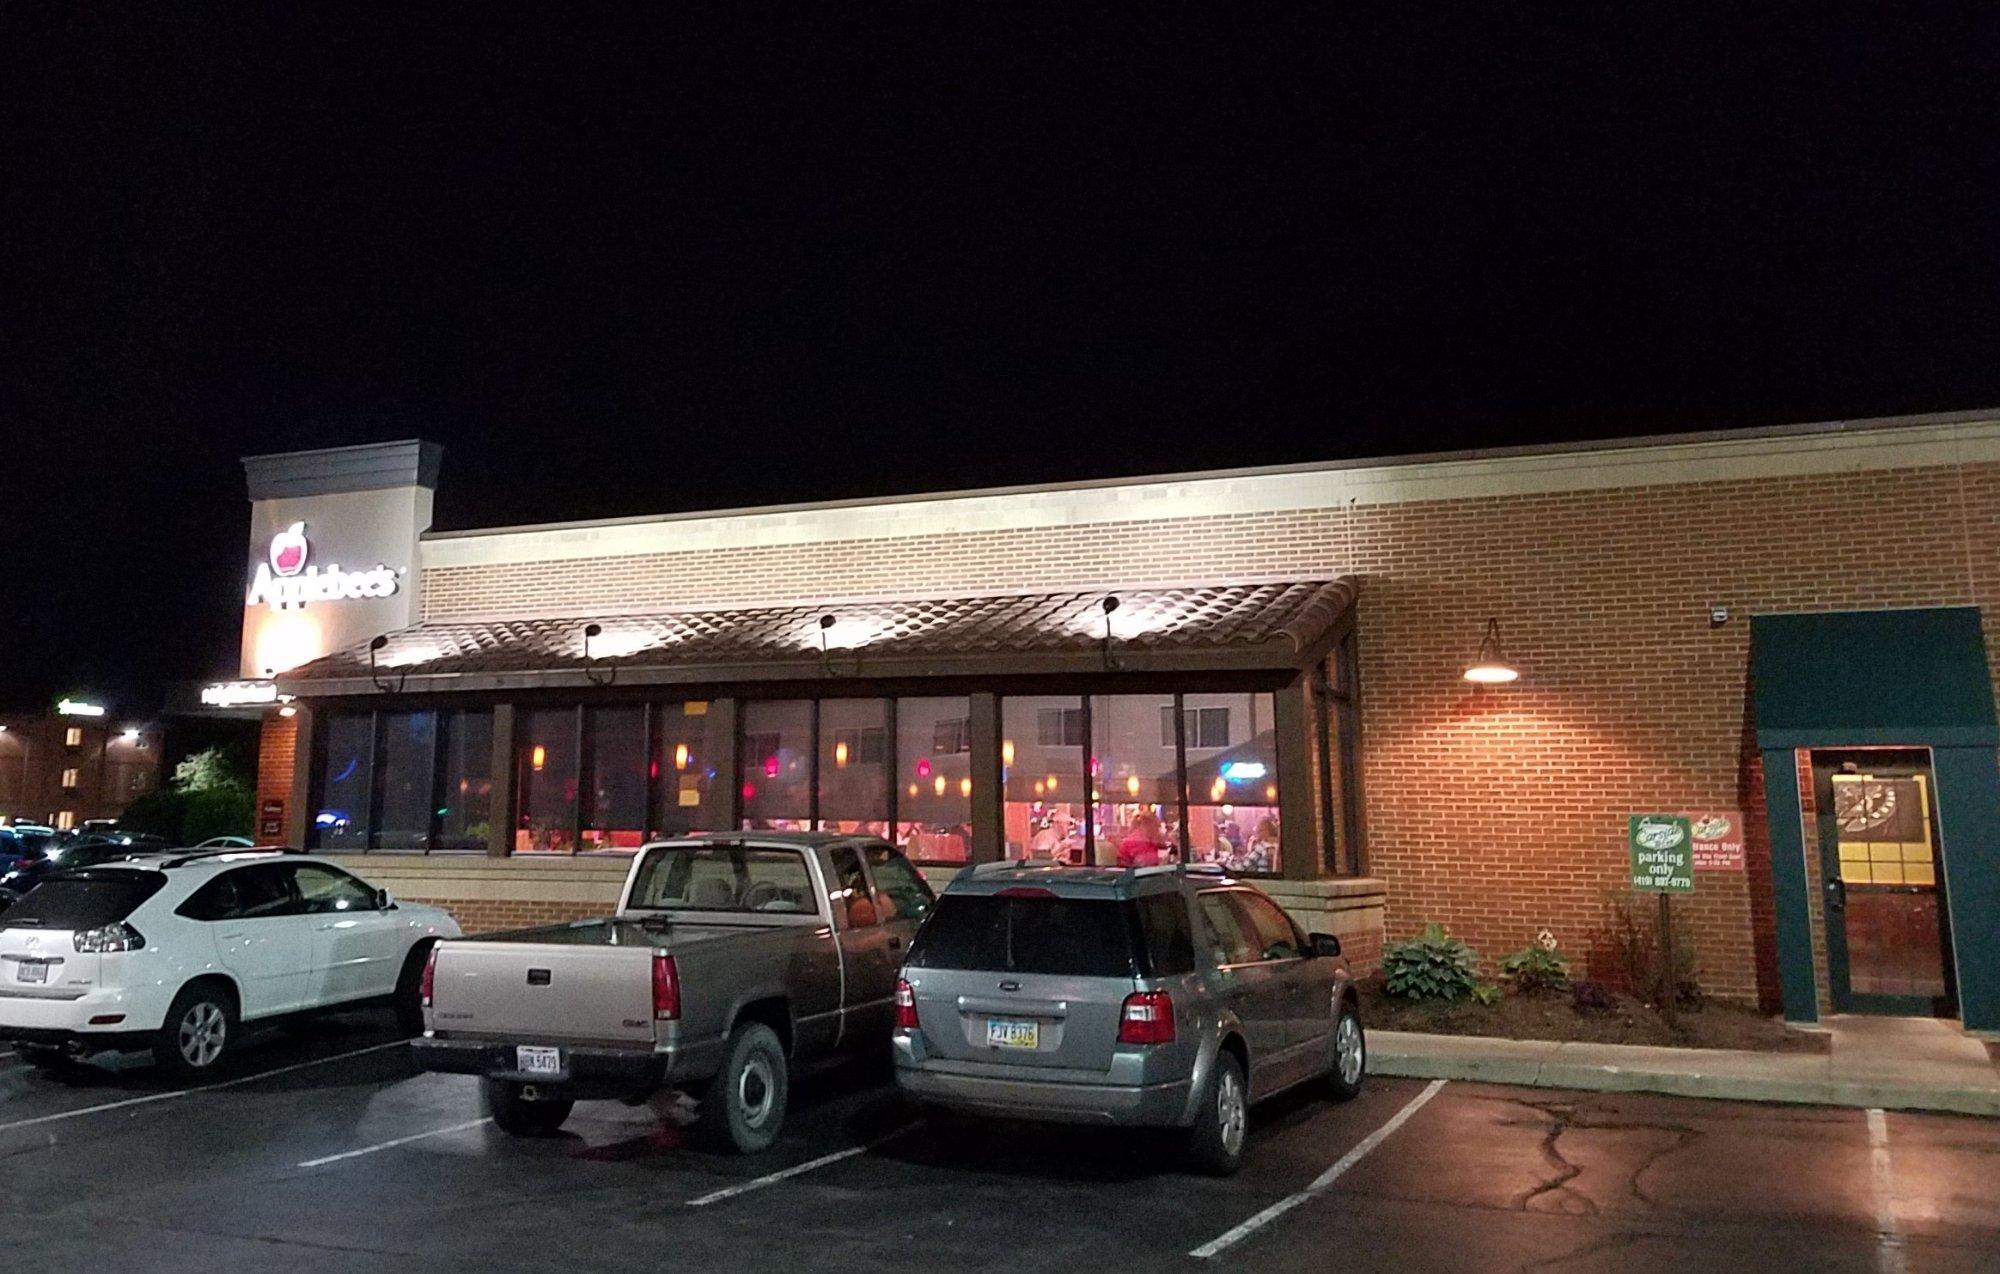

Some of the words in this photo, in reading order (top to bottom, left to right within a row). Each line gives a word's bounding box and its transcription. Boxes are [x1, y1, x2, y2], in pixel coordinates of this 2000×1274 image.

[247, 562, 399, 609] Applebee's
[1721, 842, 1741, 852] Only
[1638, 850, 1684, 867] parking
[1649, 863, 1674, 881] only
